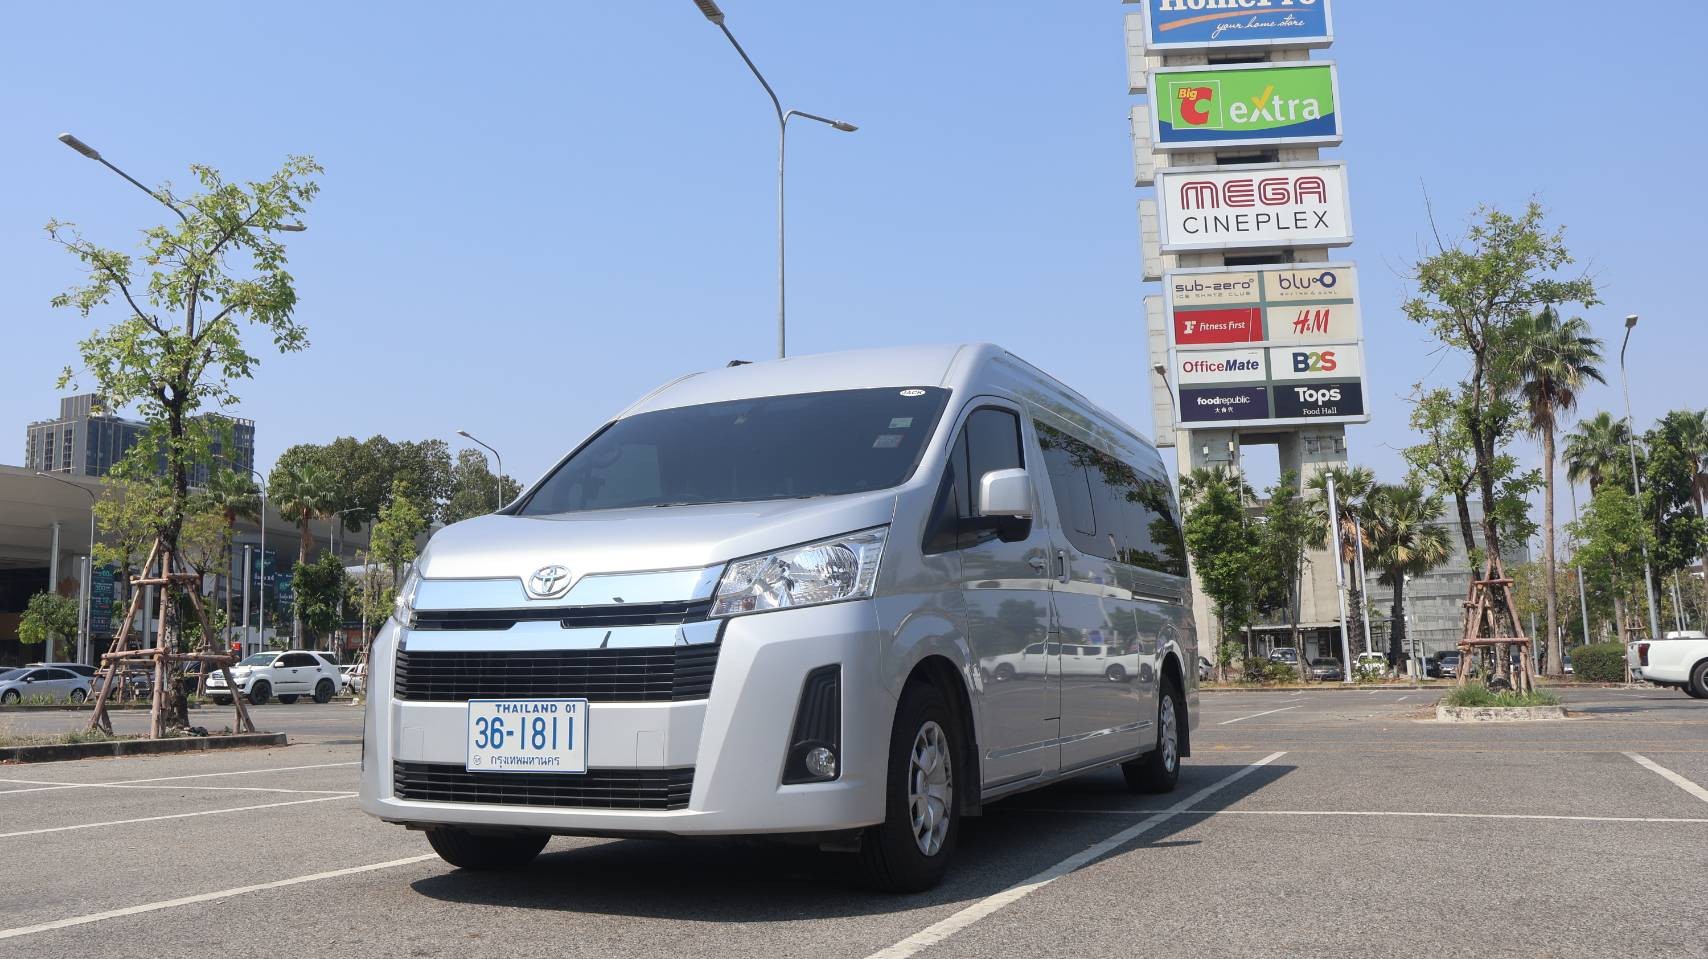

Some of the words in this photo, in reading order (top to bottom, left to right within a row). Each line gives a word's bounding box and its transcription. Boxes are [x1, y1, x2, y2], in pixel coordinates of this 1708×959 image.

[1211, 22, 1243, 39] your
[1244, 16, 1276, 29] home
[1277, 13, 1306, 27] store
[1178, 87, 1198, 100] Big
[1229, 84, 1321, 124] extra
[1180, 86, 1214, 126] C
[1180, 176, 1327, 210] MEGA
[1182, 210, 1329, 234] CINEPLEX
[1292, 309, 1330, 335] H&M
[1182, 358, 1260, 373] OfficeMate
[1292, 351, 1337, 373] B2S
[1294, 387, 1342, 405] Tops
[1302, 407, 1320, 415] Food
[1321, 406, 1337, 415] Hall
[495, 703, 558, 714] THAILAND
[565, 703, 576, 714] 01
[475, 716, 574, 751] 36-1811
[490, 754, 560, 768] กรุงเทพมหานคร
